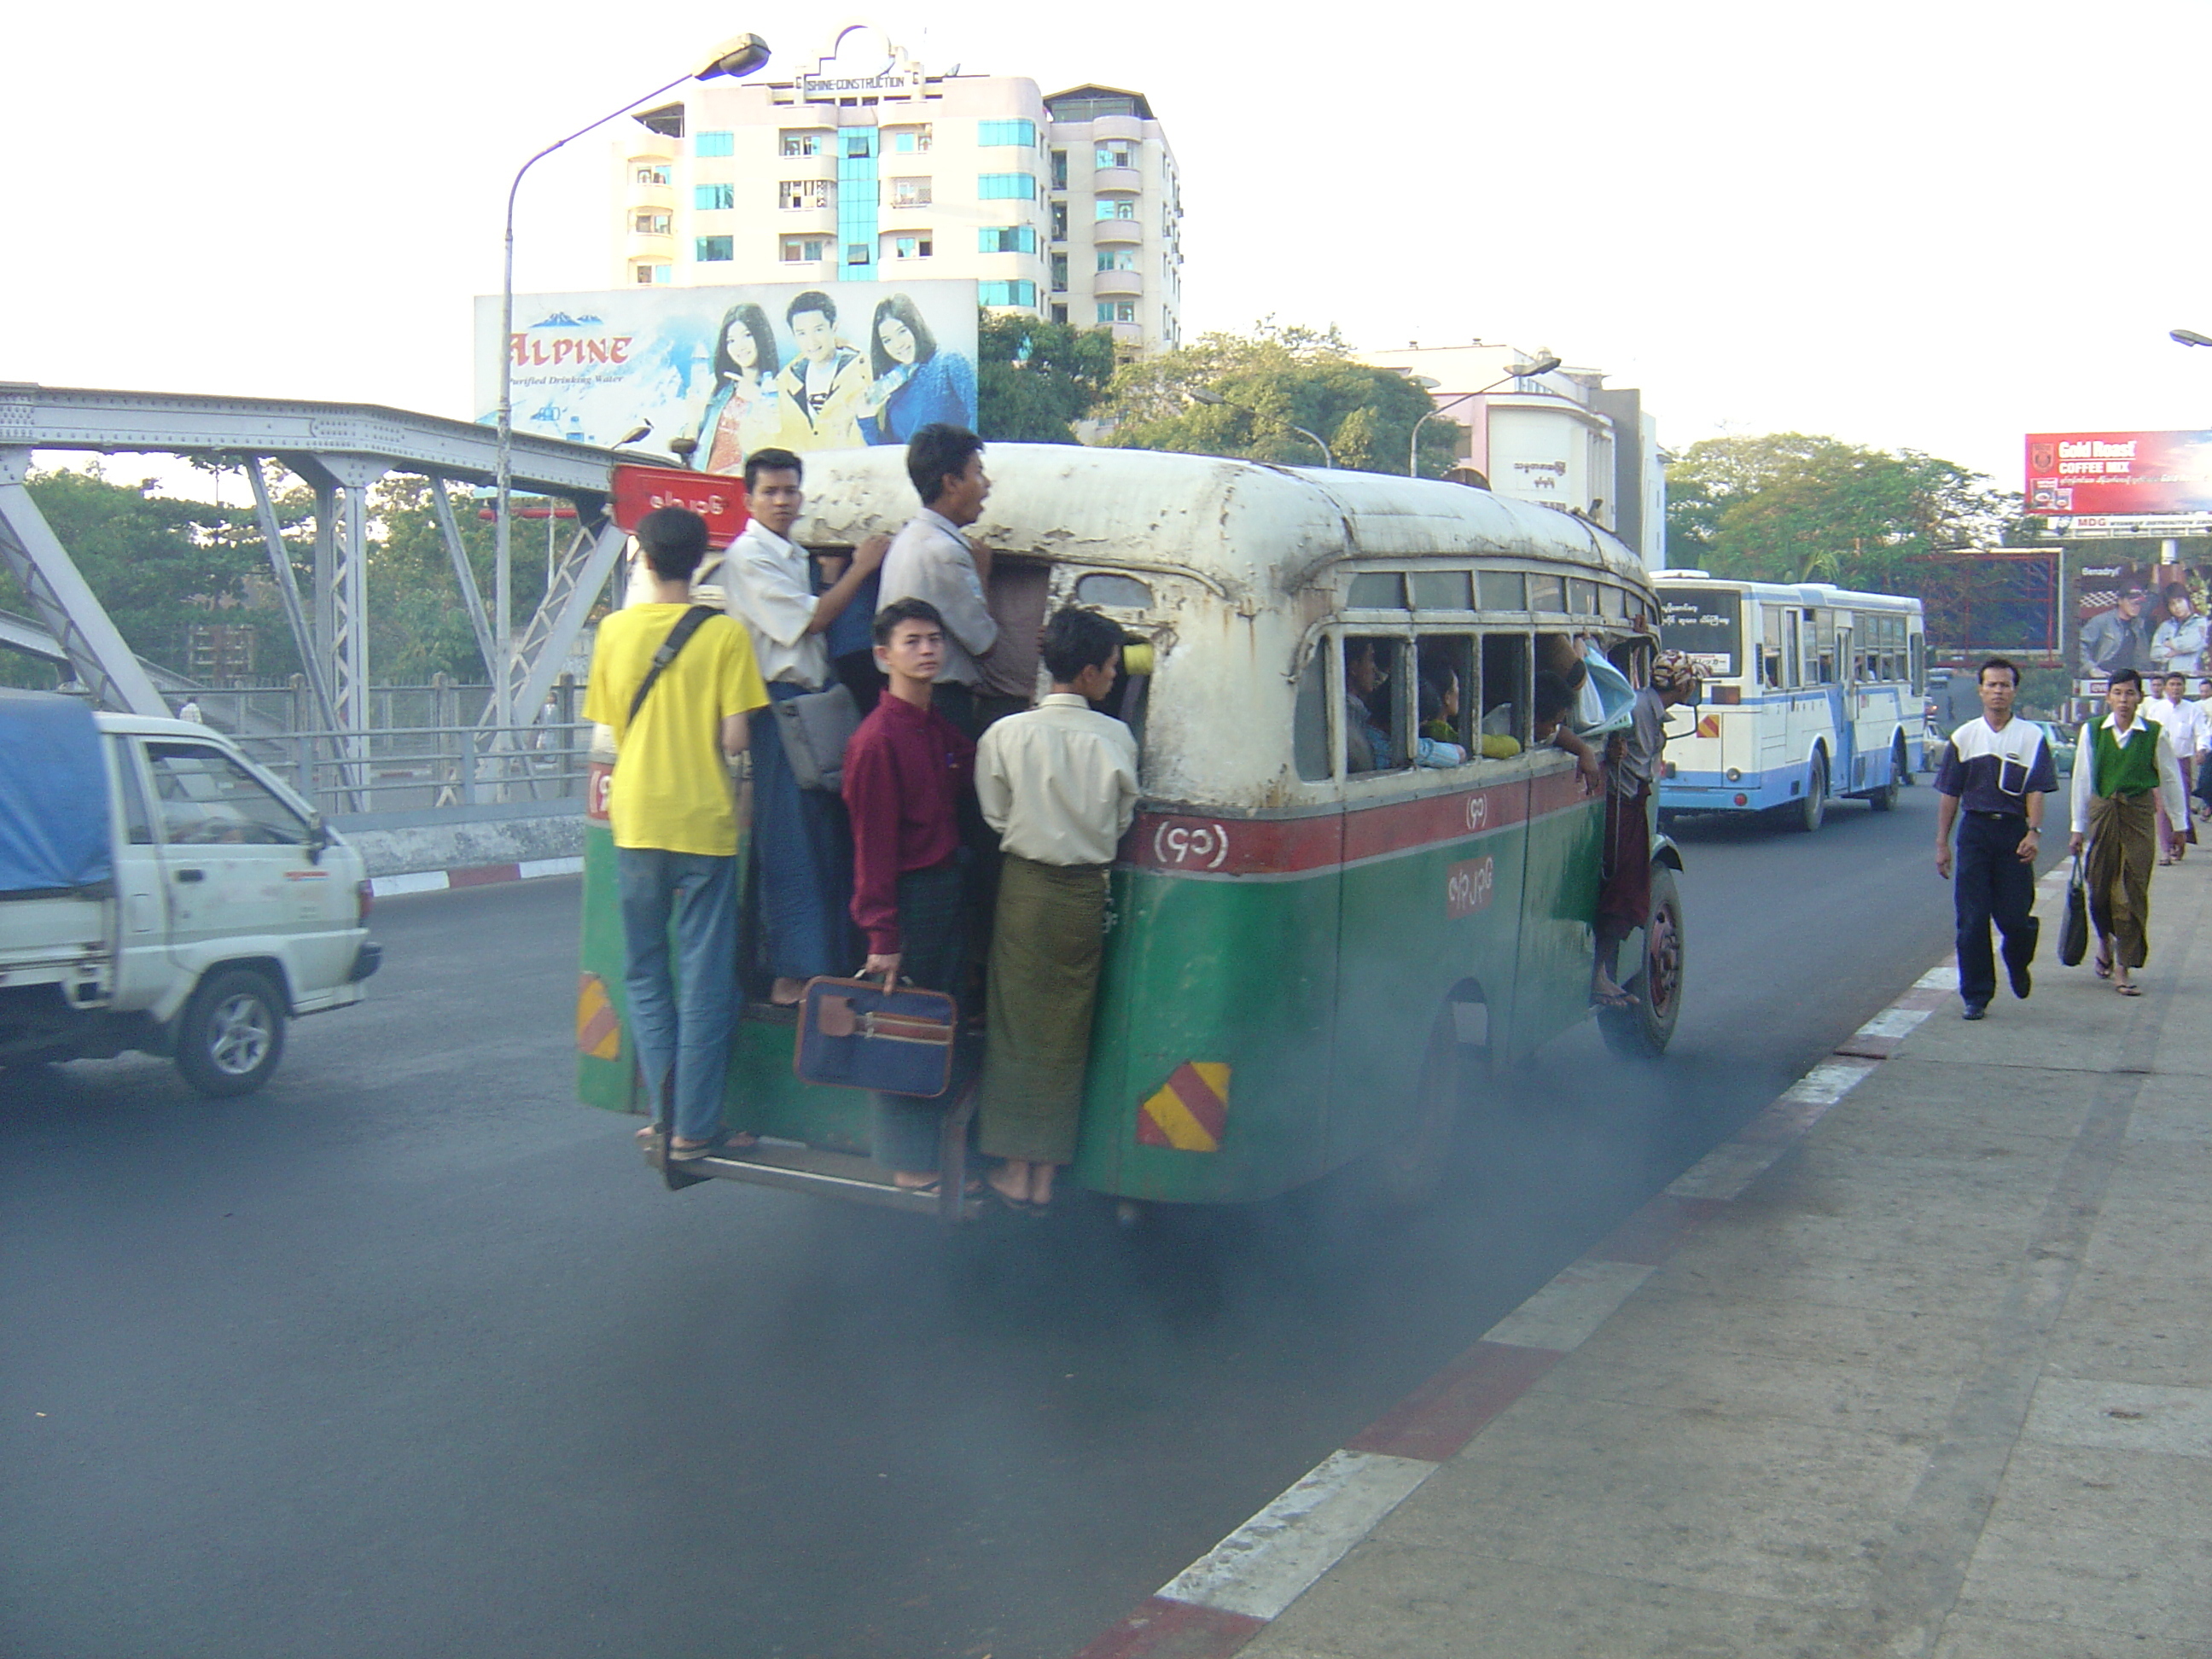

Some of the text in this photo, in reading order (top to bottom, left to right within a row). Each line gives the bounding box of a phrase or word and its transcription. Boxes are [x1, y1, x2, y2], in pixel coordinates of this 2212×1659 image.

[510, 333, 632, 366] ALPINE
[549, 376, 591, 385] Drinking
[2058, 440, 2136, 458] Gold Roast
[2058, 462, 2130, 474] COFFEE MIX
[2077, 518, 2106, 527] MDG
